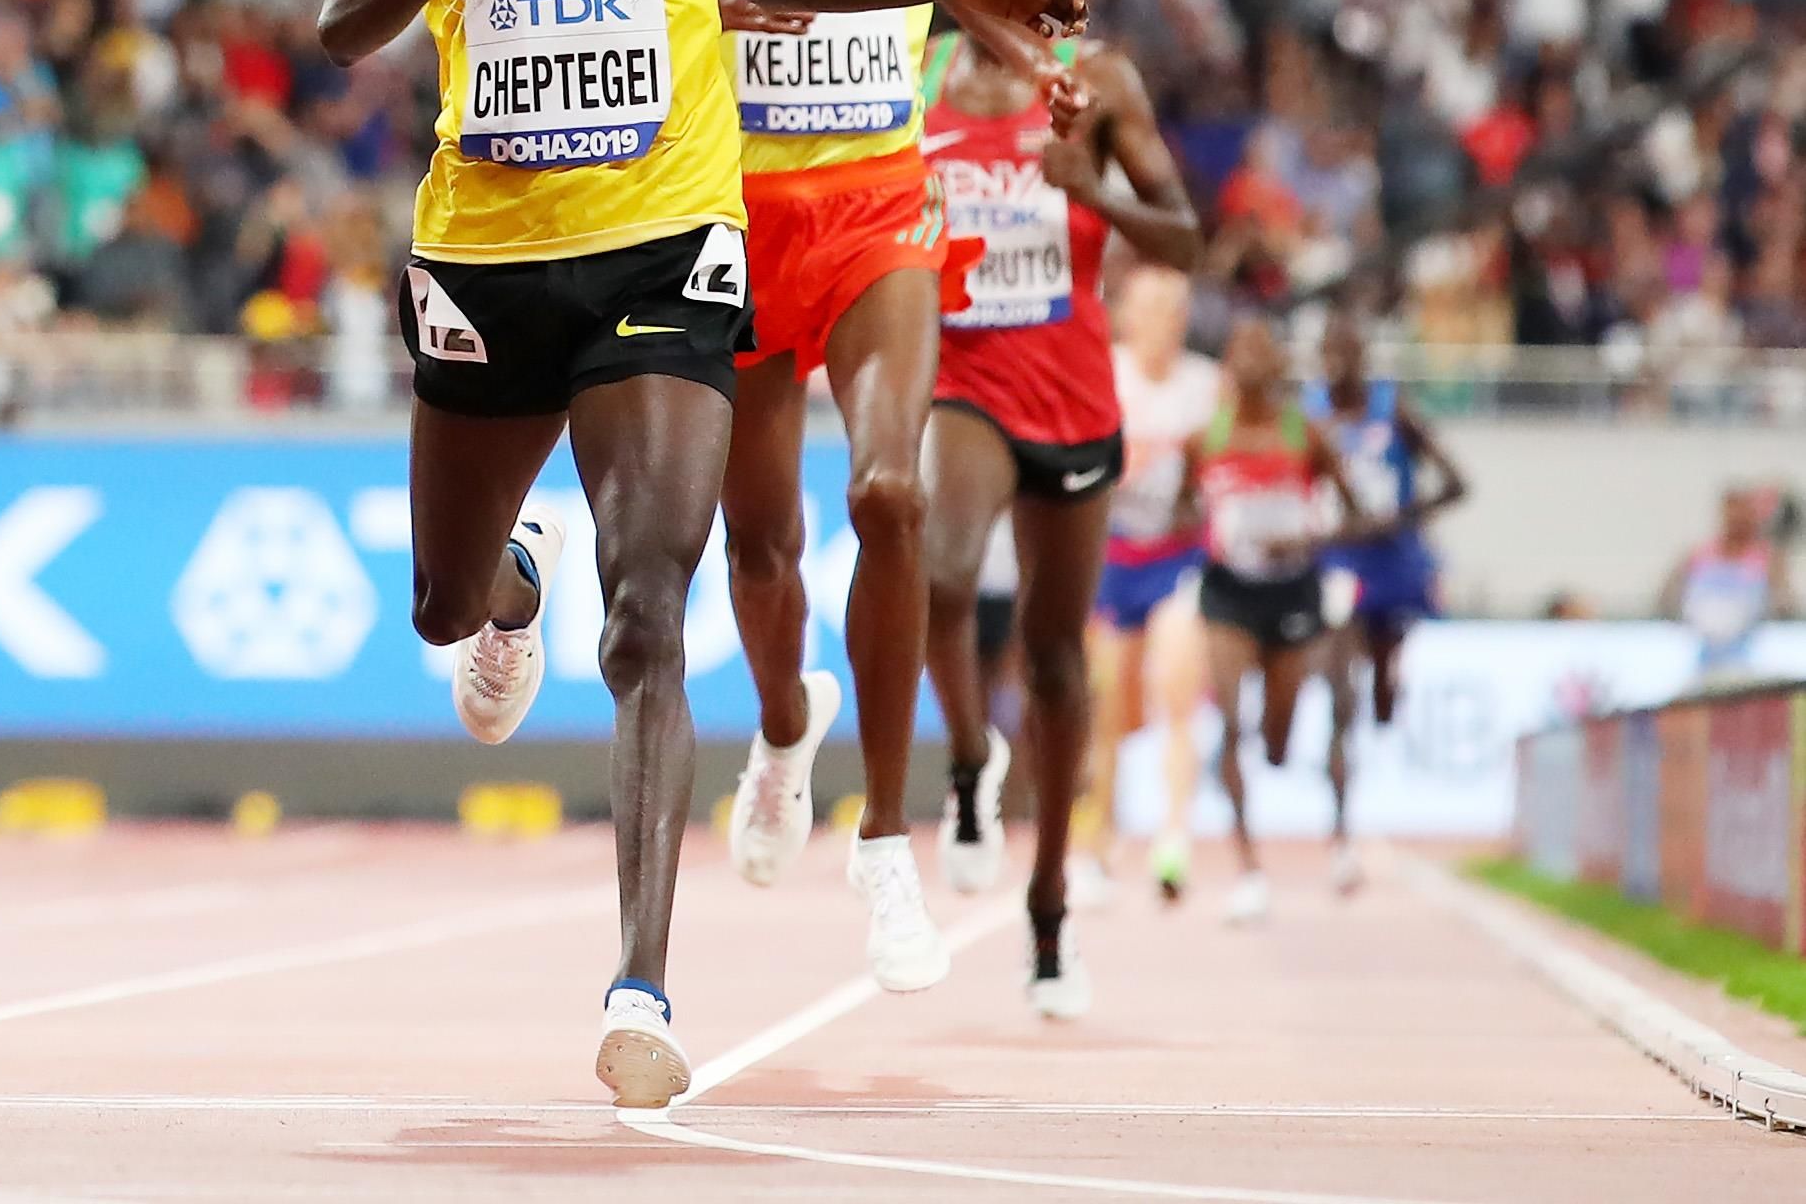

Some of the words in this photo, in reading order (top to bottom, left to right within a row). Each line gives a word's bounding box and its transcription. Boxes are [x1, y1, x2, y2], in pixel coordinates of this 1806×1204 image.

[745, 36, 903, 87] KEJELCHA
[473, 48, 660, 119] CHEPTEGEI
[765, 102, 895, 131] DOHA2019
[490, 127, 640, 162] DOHA2019
